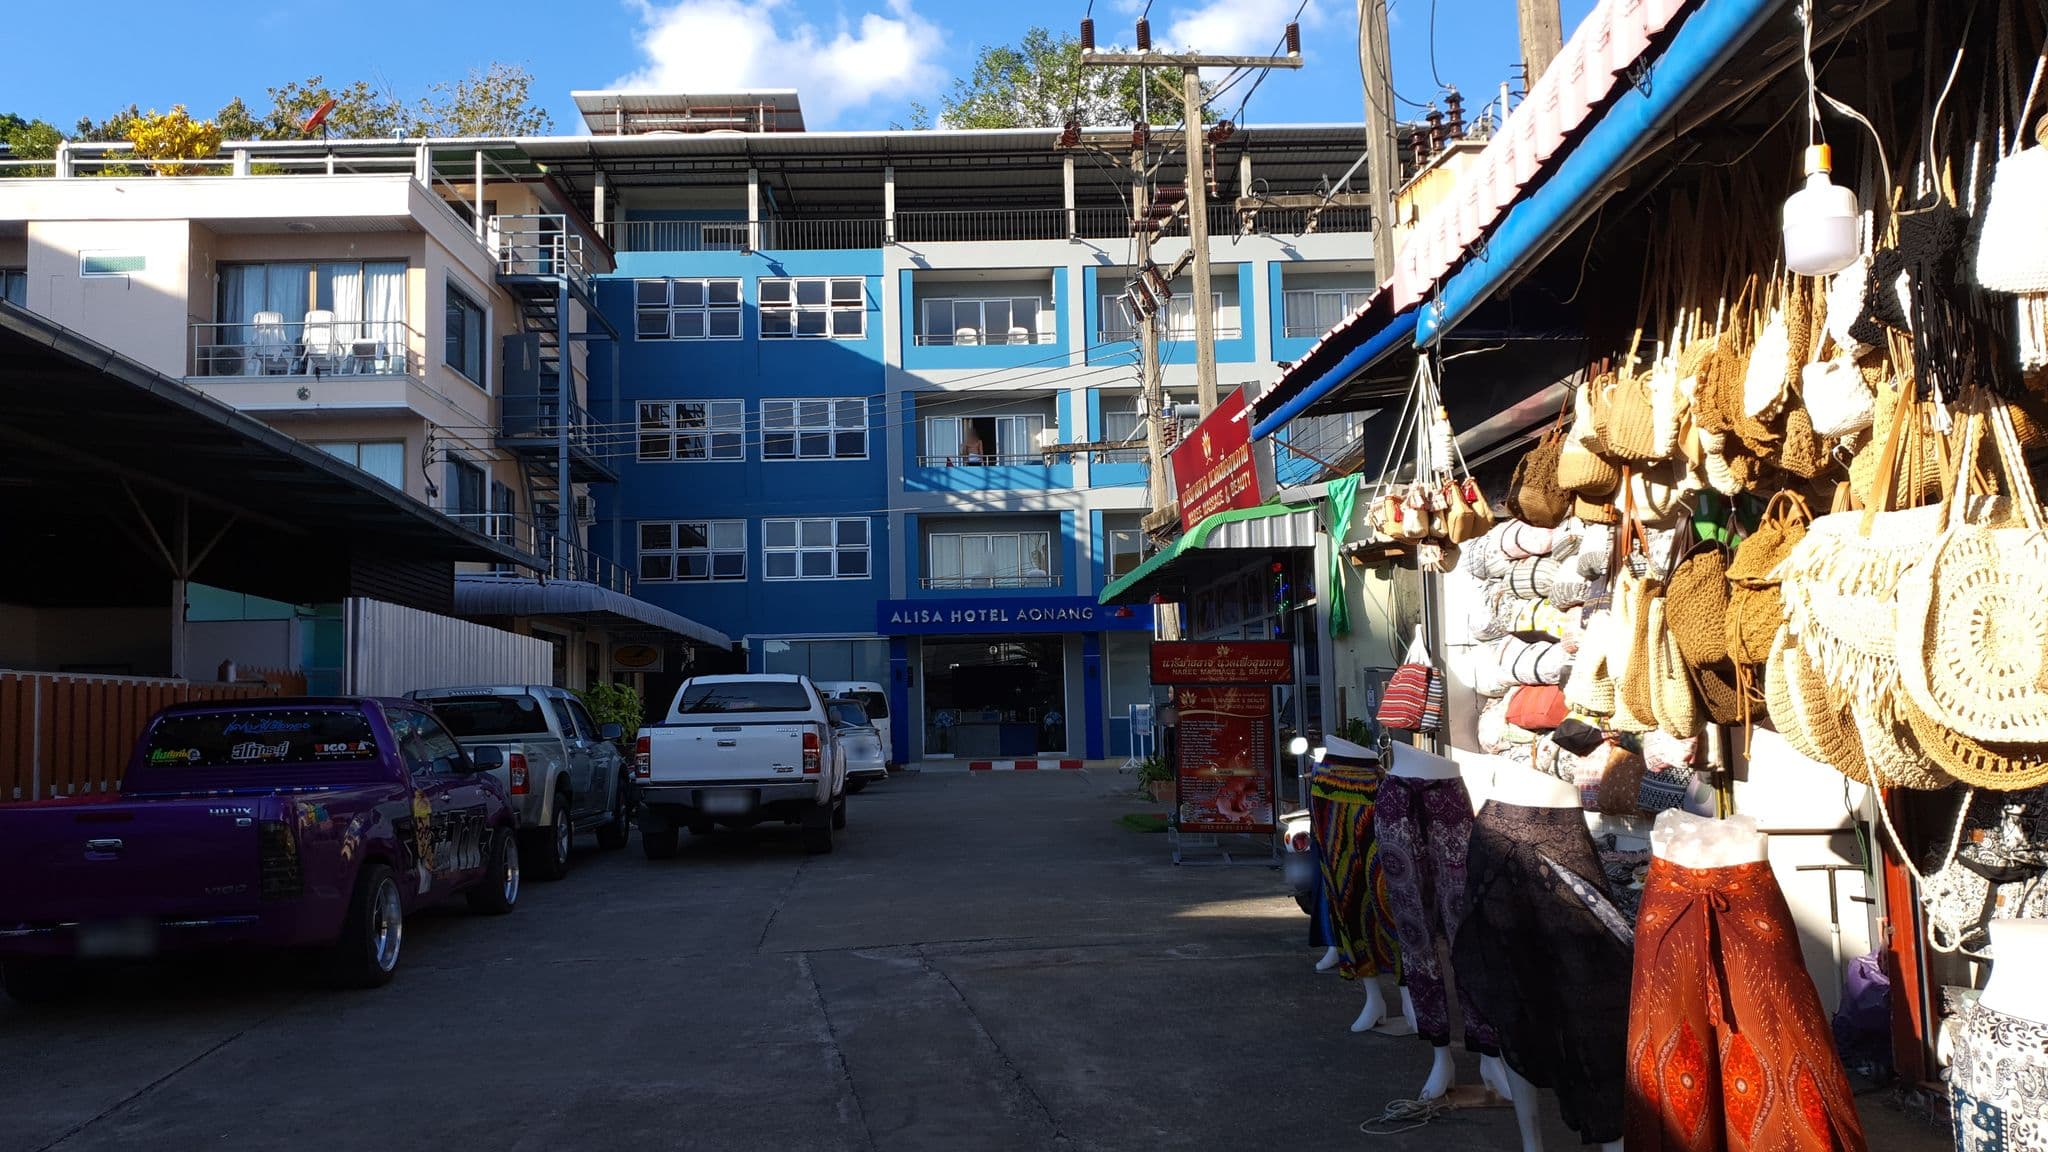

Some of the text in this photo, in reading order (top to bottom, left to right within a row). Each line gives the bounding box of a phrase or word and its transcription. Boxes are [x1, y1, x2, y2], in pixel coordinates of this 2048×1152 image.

[1203, 489, 1225, 516] MASSAGE
[1225, 486, 1231, 505] &
[1231, 471, 1250, 497] BEAUTY
[890, 607, 1093, 624] ALISA HOTEL AONANG
[1248, 668, 1279, 676] BEAUTY
[314, 743, 347, 752] VIGO
